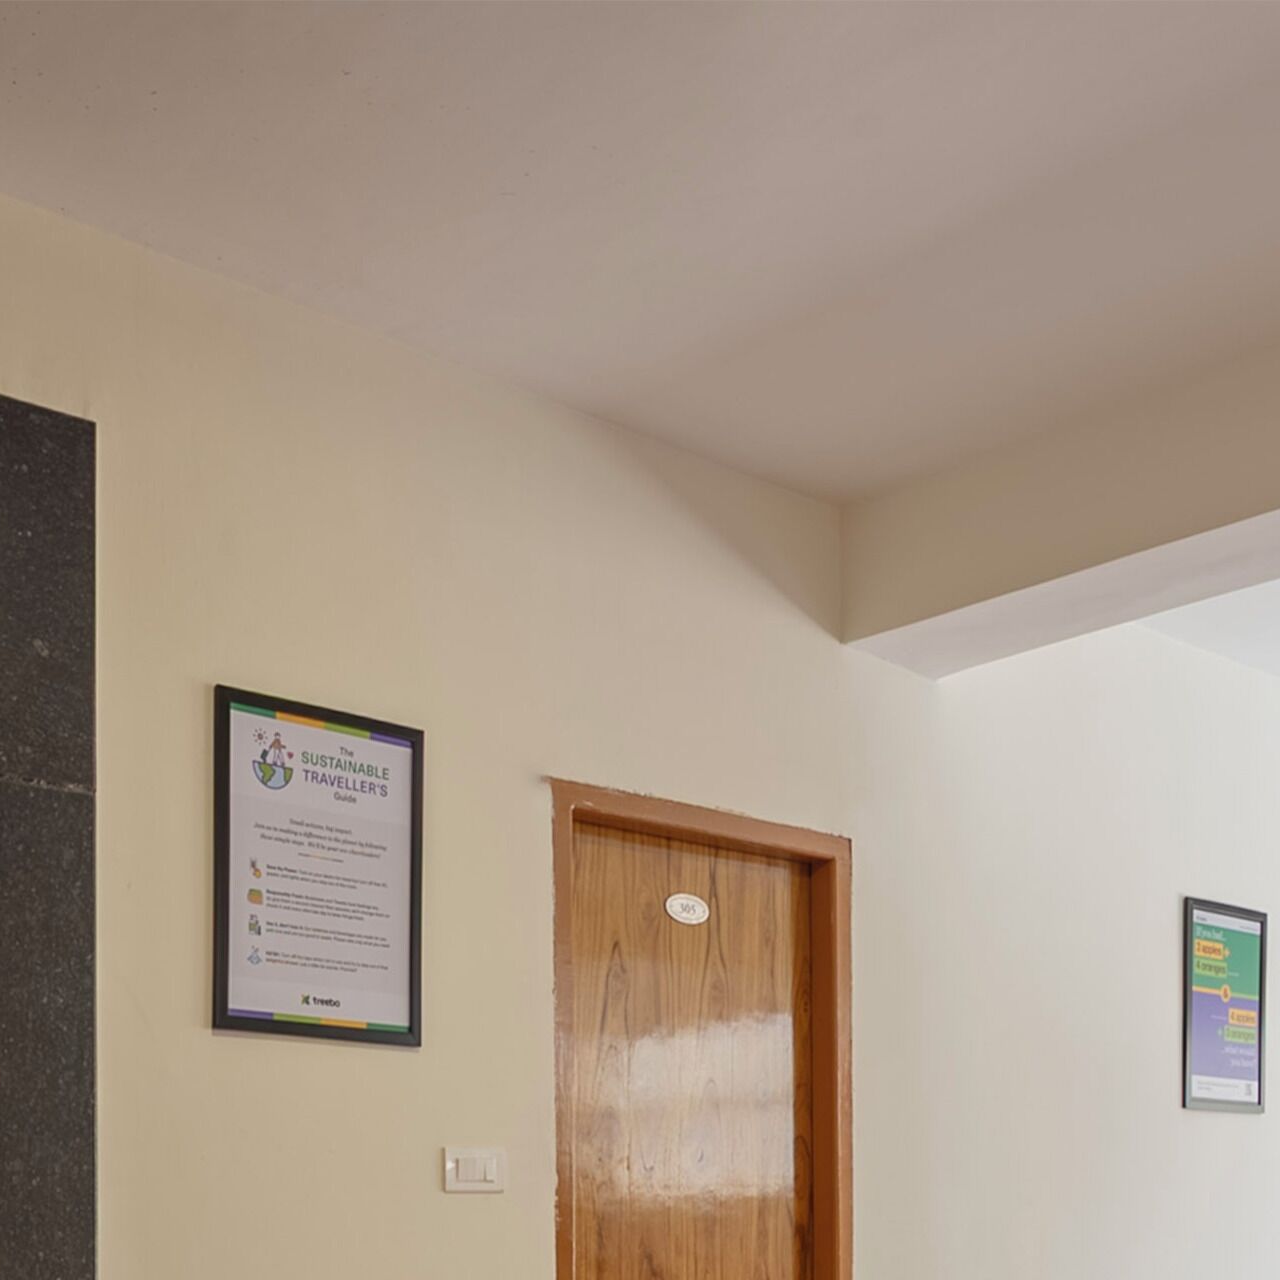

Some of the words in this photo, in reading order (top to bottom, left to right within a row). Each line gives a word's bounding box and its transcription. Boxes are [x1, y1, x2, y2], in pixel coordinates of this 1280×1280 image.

[340, 746, 354, 757] The
[301, 751, 390, 781] SUSTAINABLE
[302, 769, 388, 798] TRAVELLER'S
[333, 791, 357, 803] Guide
